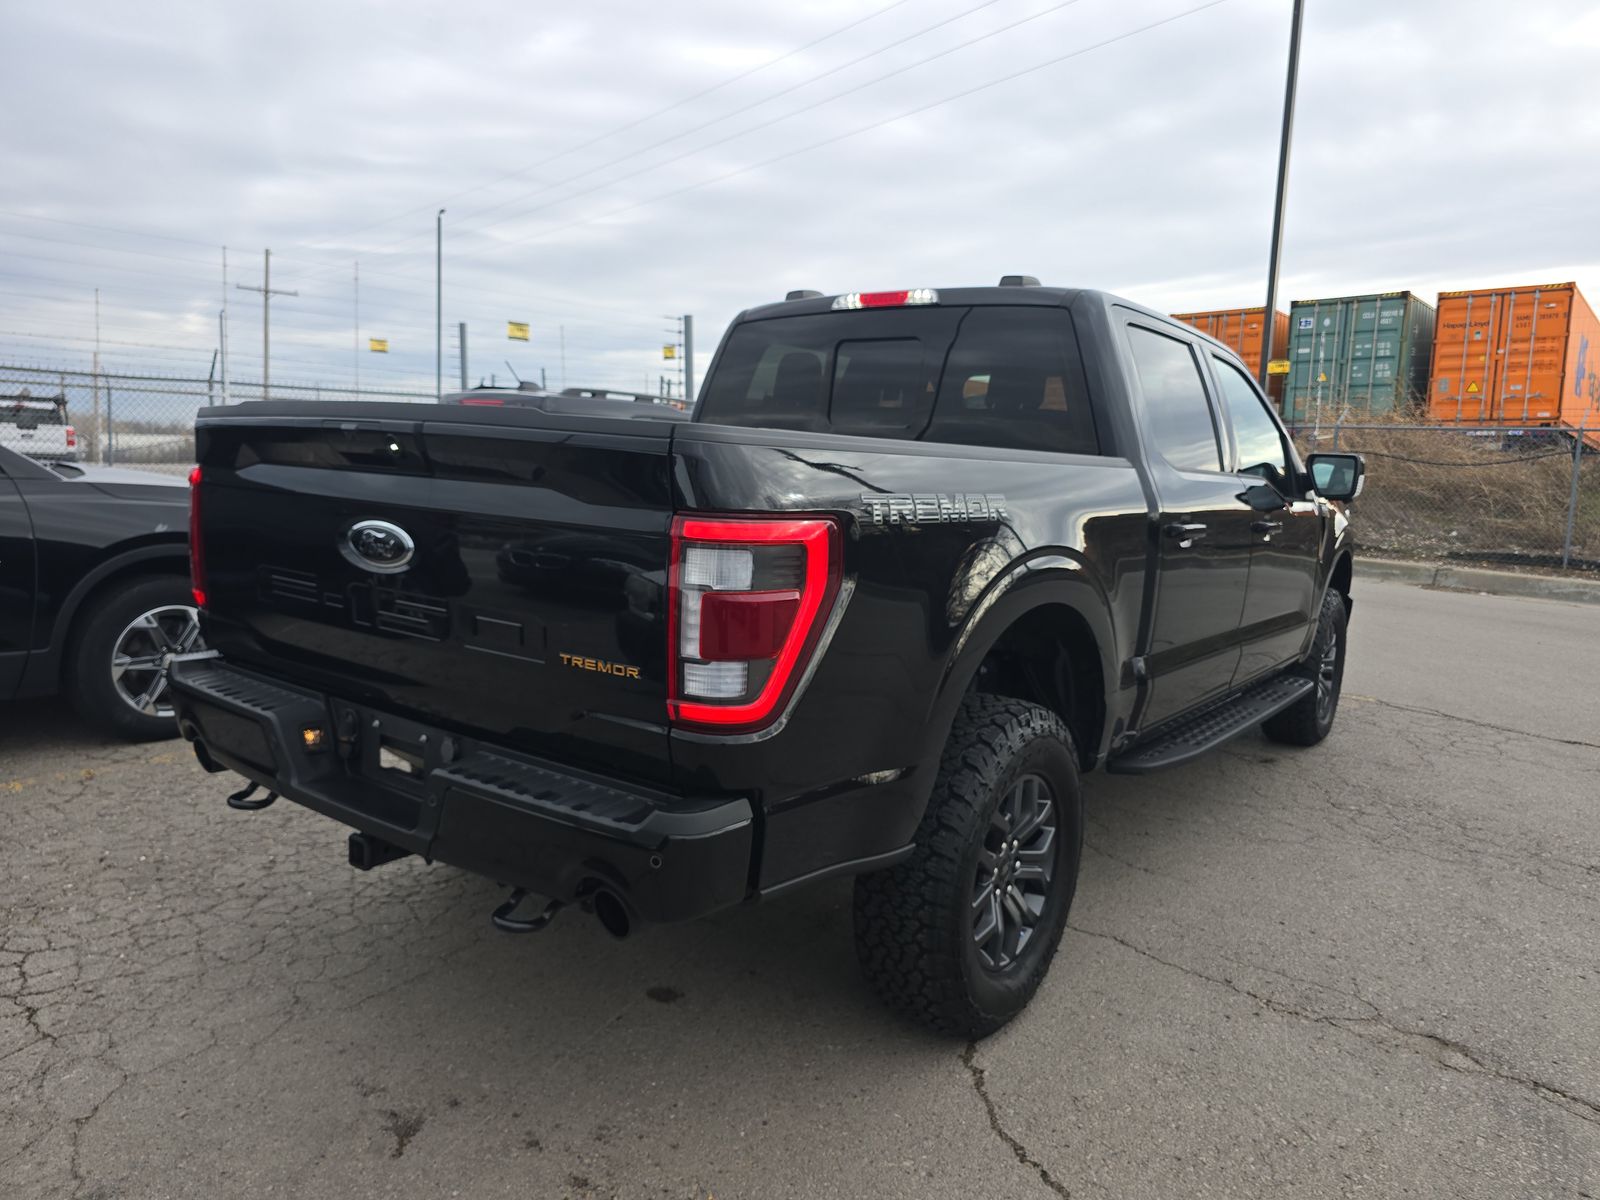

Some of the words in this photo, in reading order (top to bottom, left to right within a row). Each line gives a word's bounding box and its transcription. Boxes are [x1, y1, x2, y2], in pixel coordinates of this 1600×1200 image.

[1442, 319, 1490, 330] HapagLloyd
[860, 493, 1011, 525] TREMOR
[559, 652, 642, 680] TREMOR
